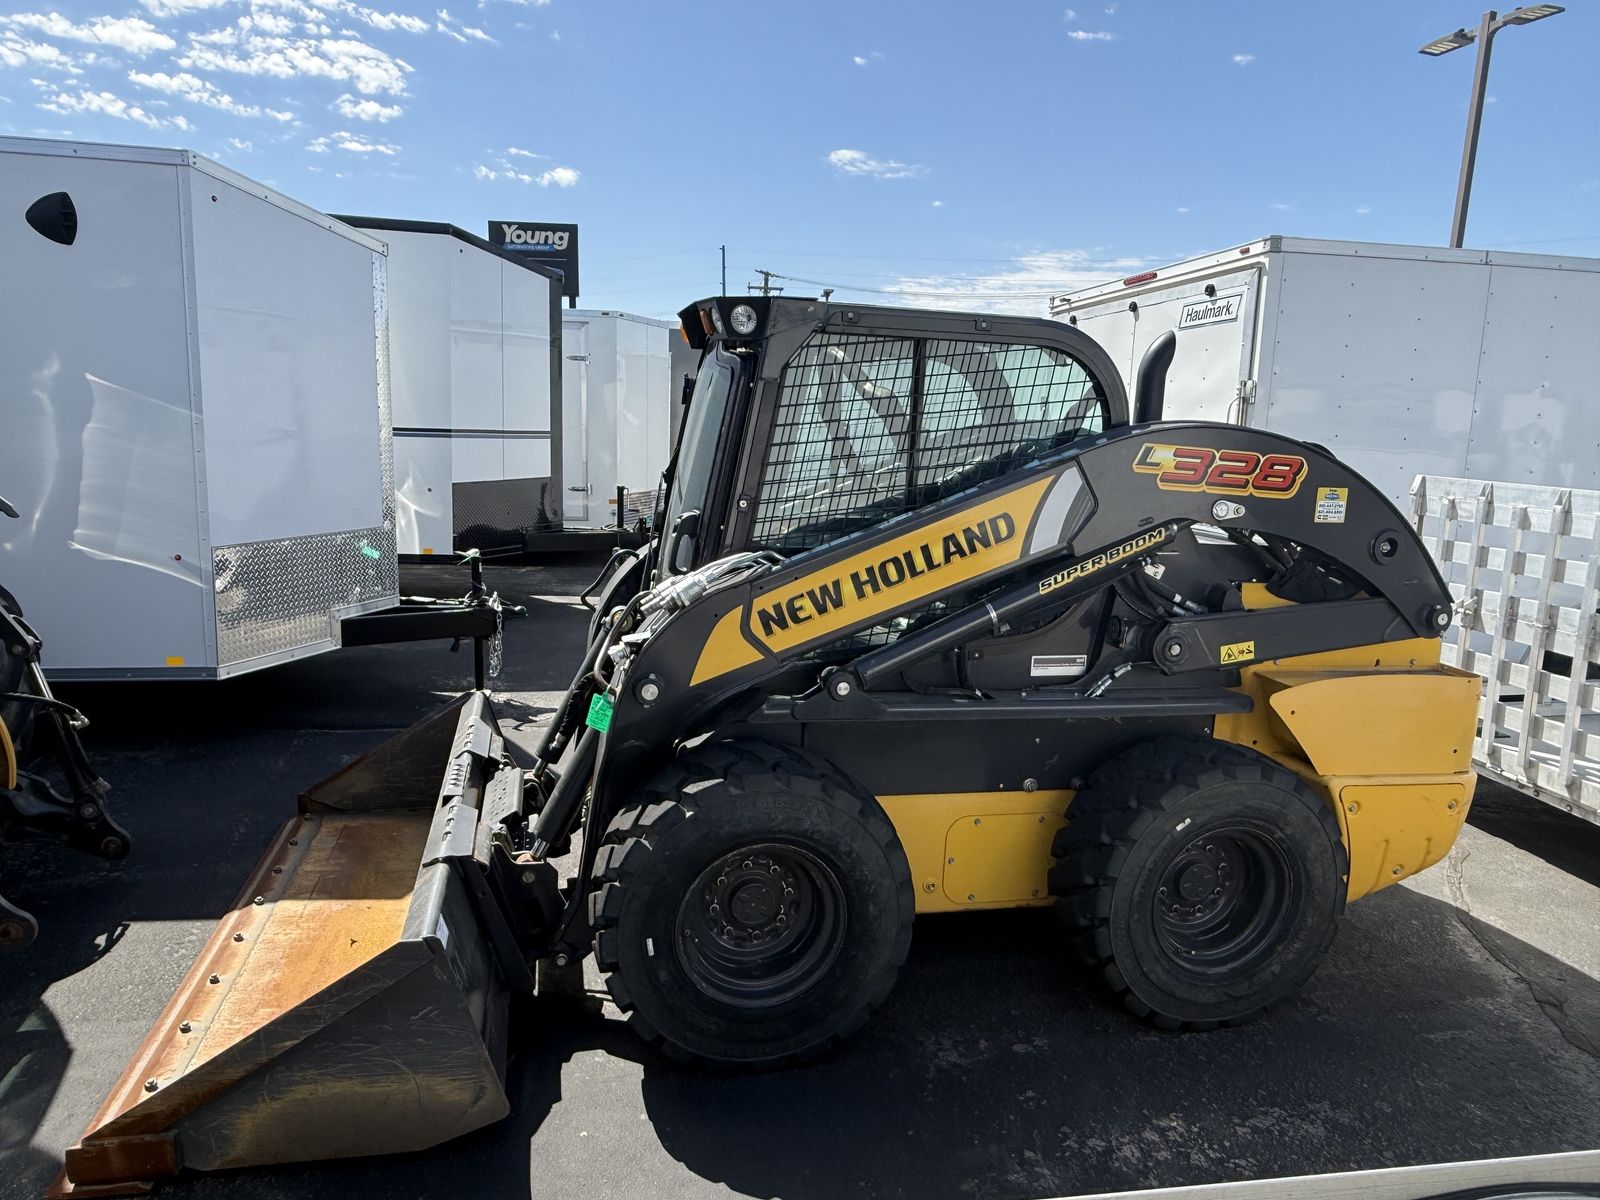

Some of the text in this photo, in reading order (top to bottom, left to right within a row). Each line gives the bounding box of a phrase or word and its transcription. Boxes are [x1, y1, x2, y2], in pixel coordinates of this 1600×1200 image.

[501, 224, 570, 250] Young
[1184, 300, 1233, 323] Haulmark
[1133, 443, 1306, 496] L328
[757, 511, 1016, 639] NEW HOLLAND
[1039, 527, 1165, 595] SUPER BOOM
